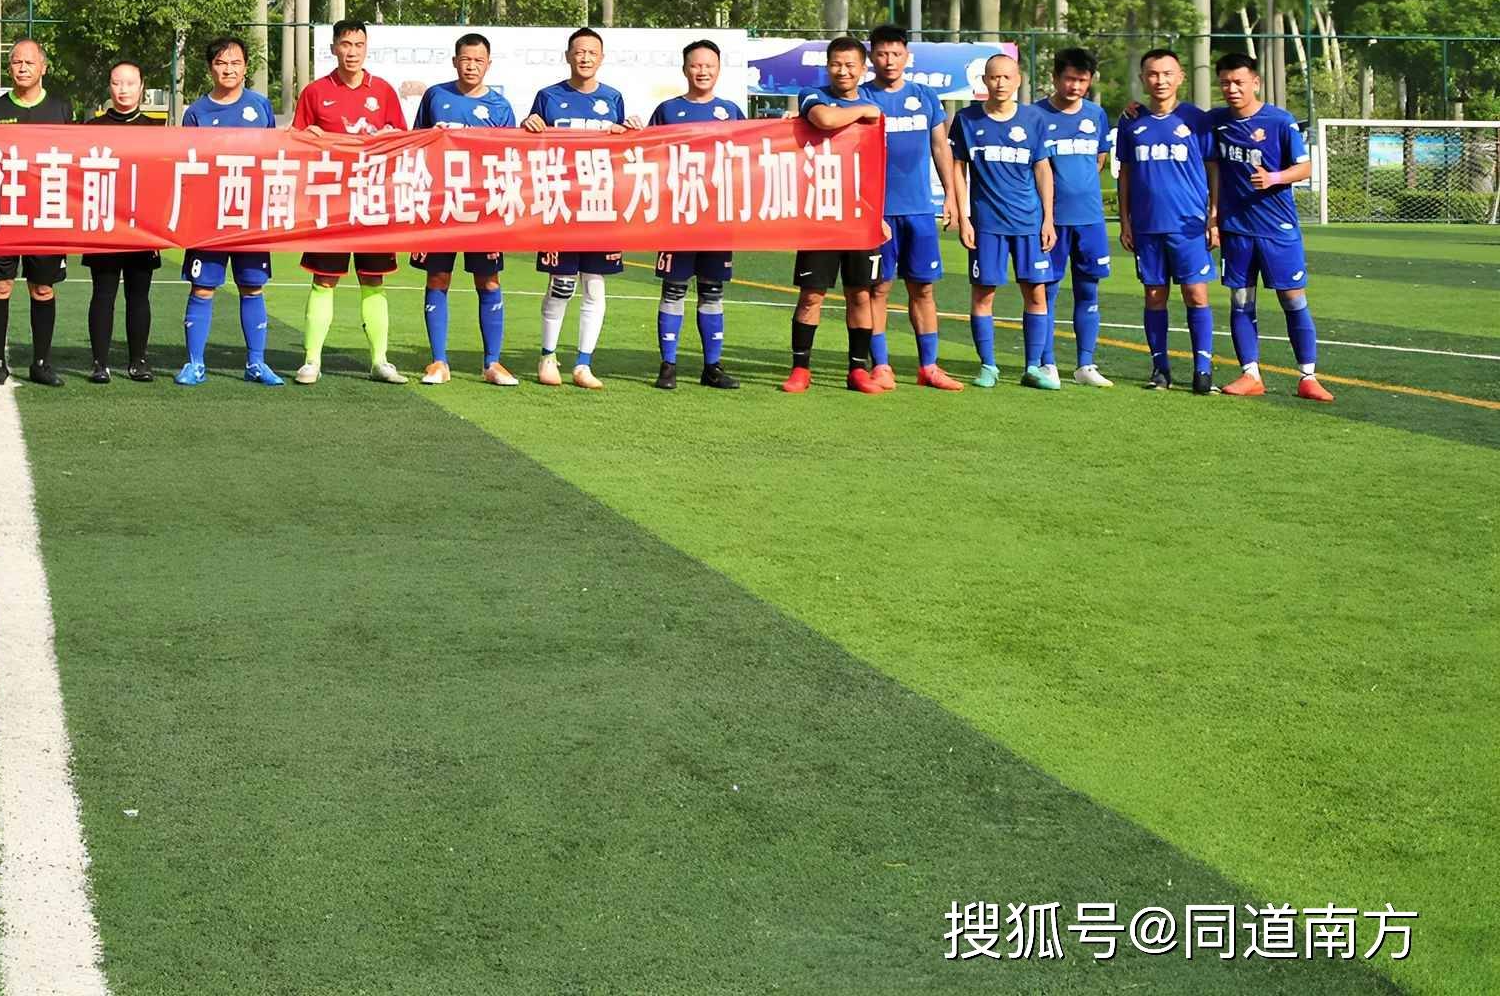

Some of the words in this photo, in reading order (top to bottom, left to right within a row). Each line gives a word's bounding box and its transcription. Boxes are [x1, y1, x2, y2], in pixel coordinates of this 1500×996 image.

[191, 259, 202, 278] 8
[657, 251, 672, 272] 61
[972, 259, 980, 278] 6
